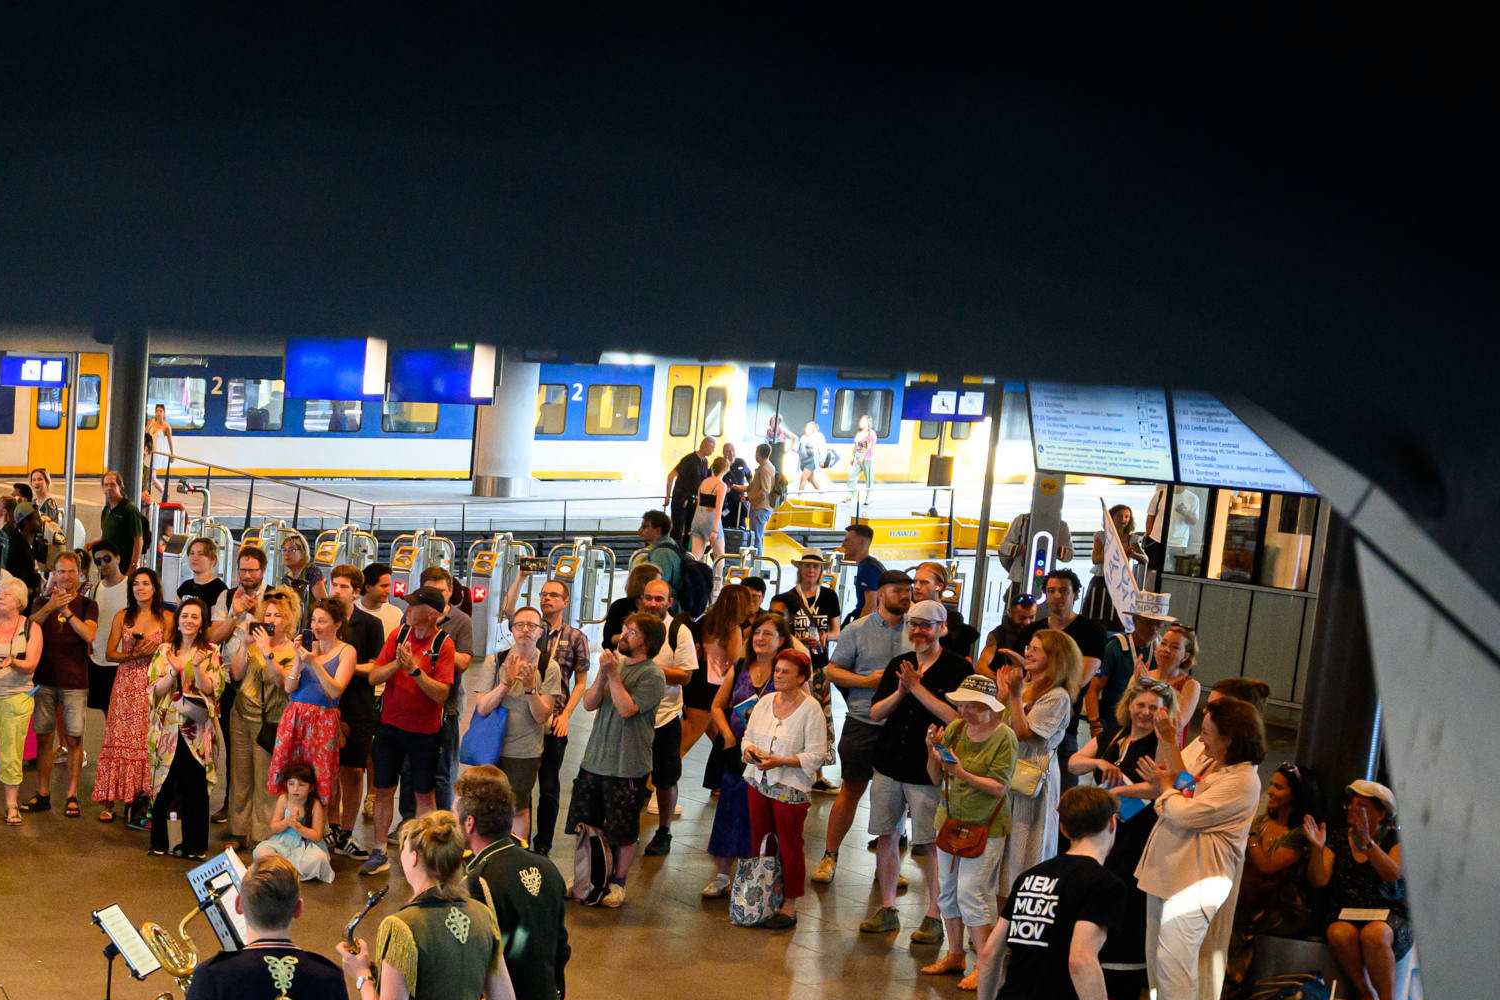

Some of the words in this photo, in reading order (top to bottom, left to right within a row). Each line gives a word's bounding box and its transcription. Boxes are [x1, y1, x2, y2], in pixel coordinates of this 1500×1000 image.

[211, 376, 223, 395] 2
[572, 383, 583, 401] 2
[1013, 897, 1058, 918] MUSIC
